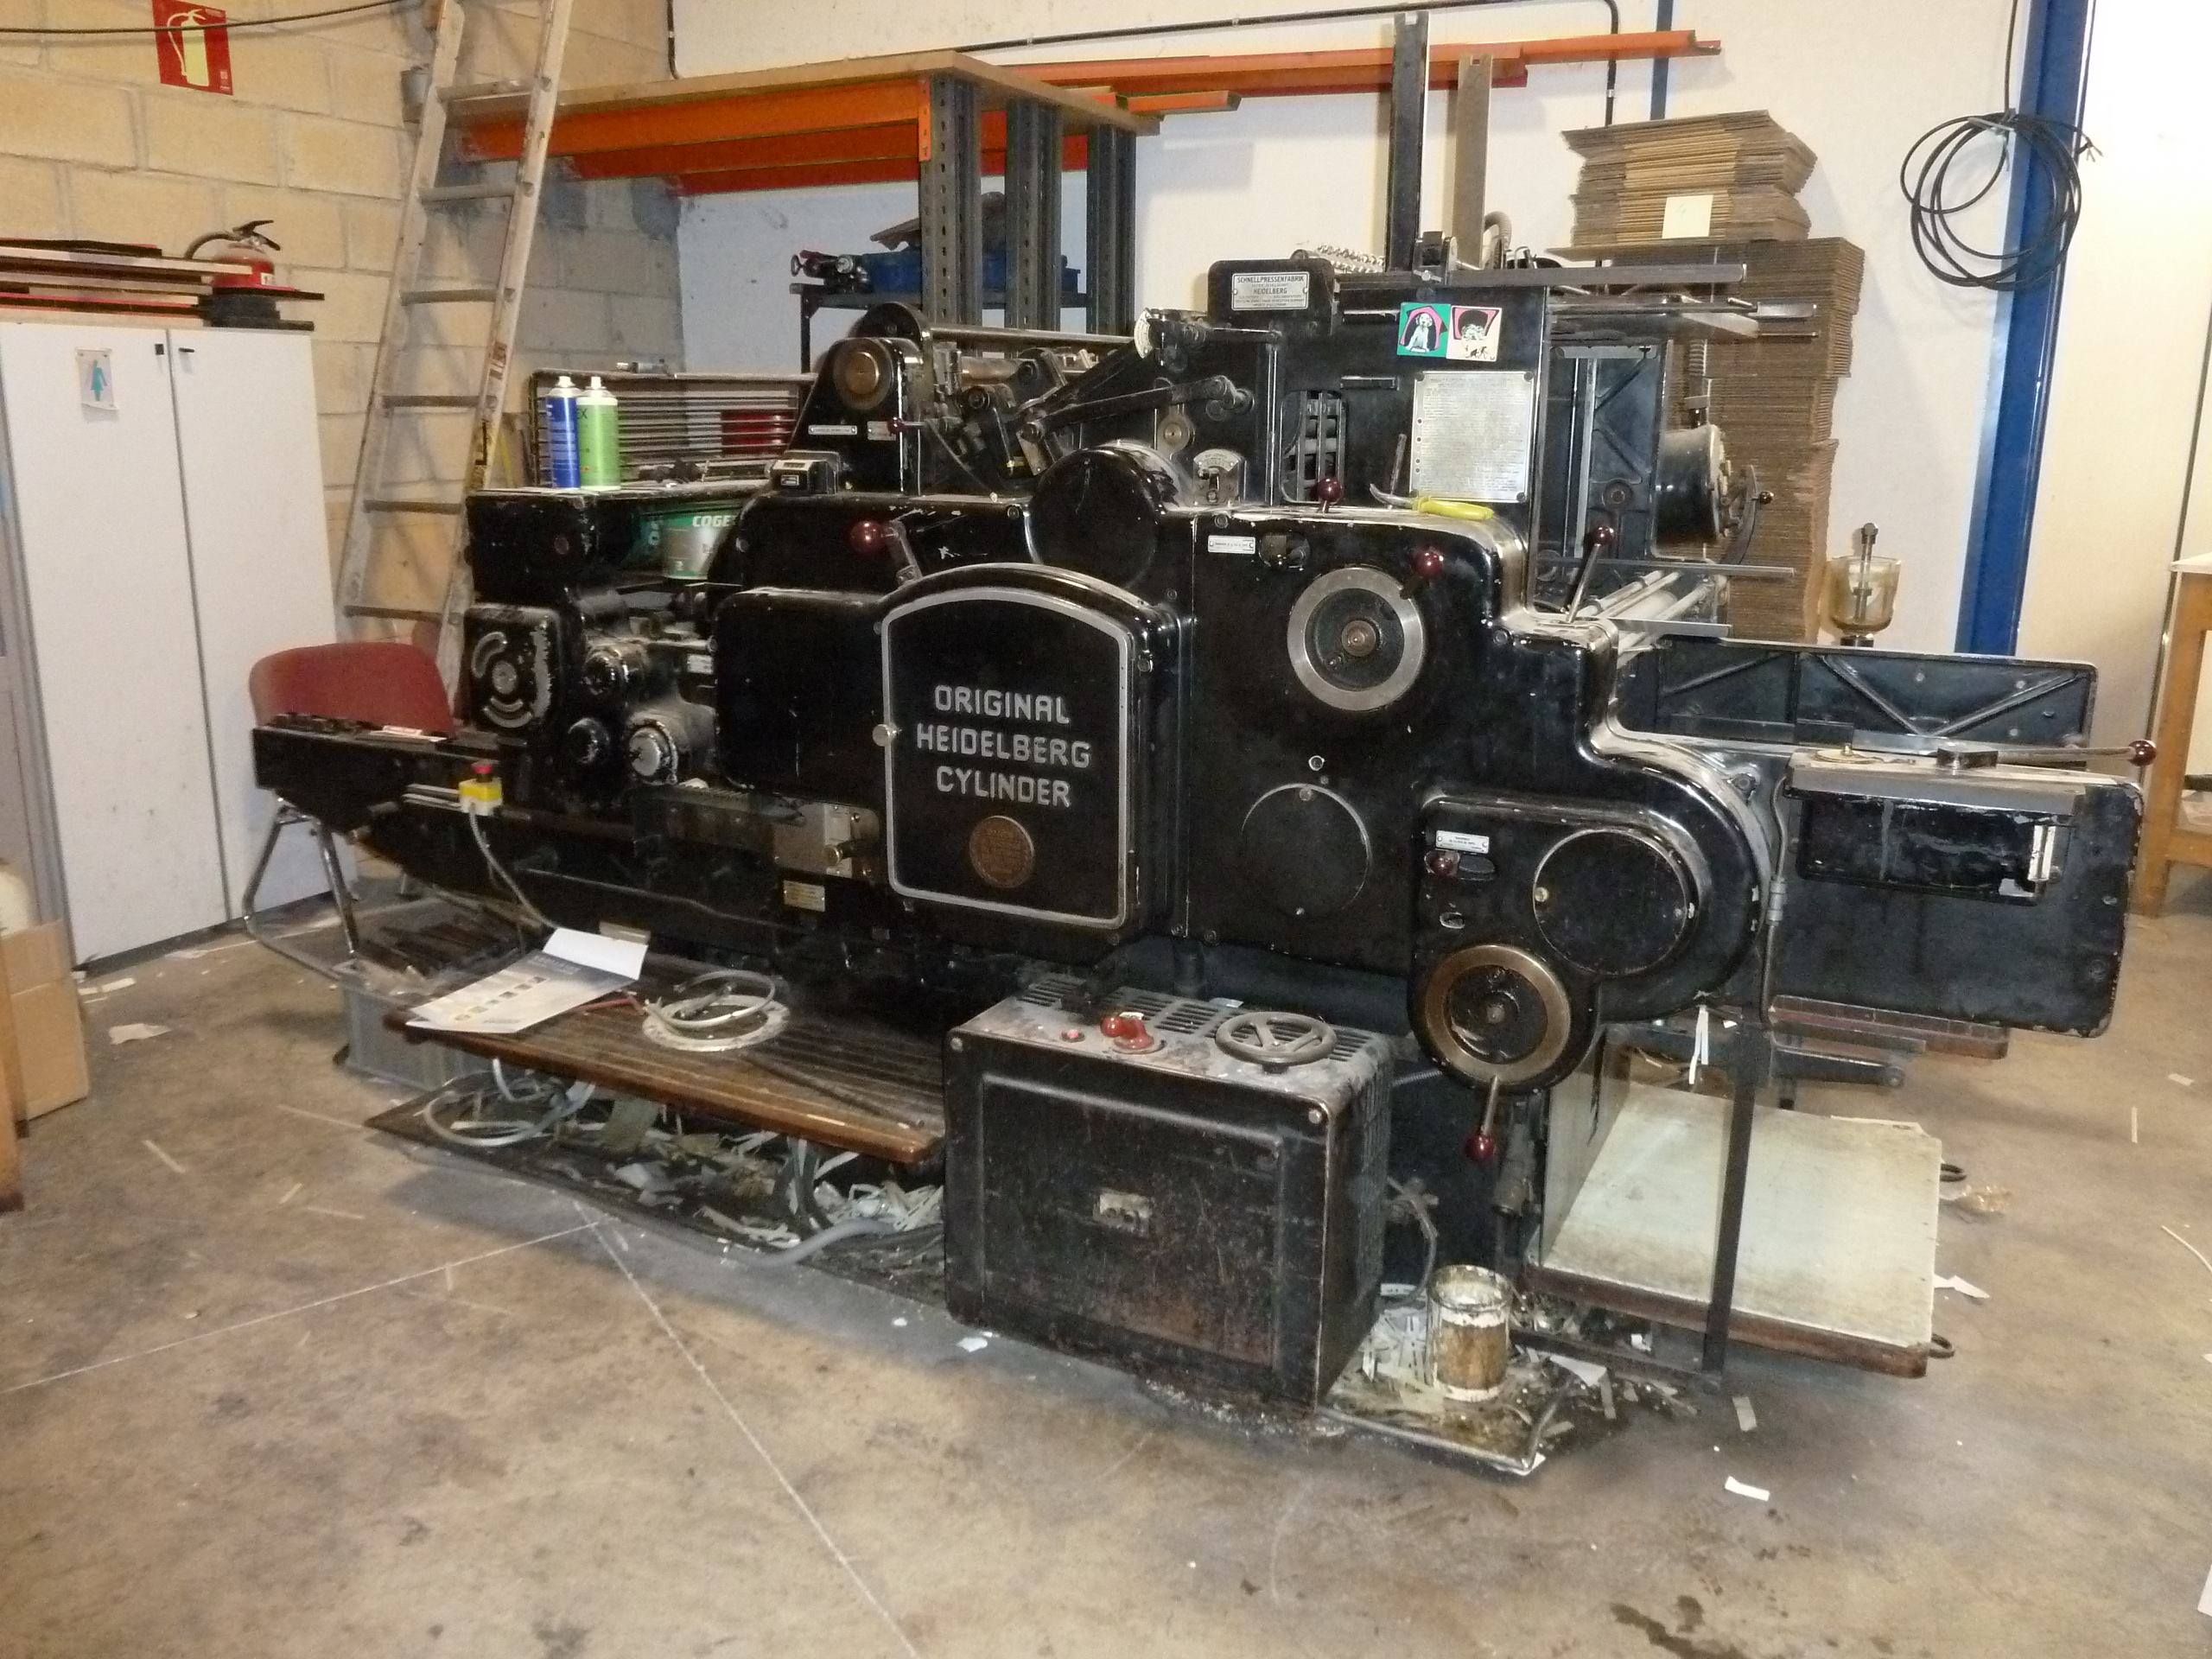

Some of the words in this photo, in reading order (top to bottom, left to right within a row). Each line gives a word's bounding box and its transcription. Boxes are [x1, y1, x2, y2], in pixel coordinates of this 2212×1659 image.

[934, 684, 1070, 724] ORIGINAL
[916, 722, 1091, 769] HEIDELBERG
[936, 766, 1071, 808] CYLINDER
